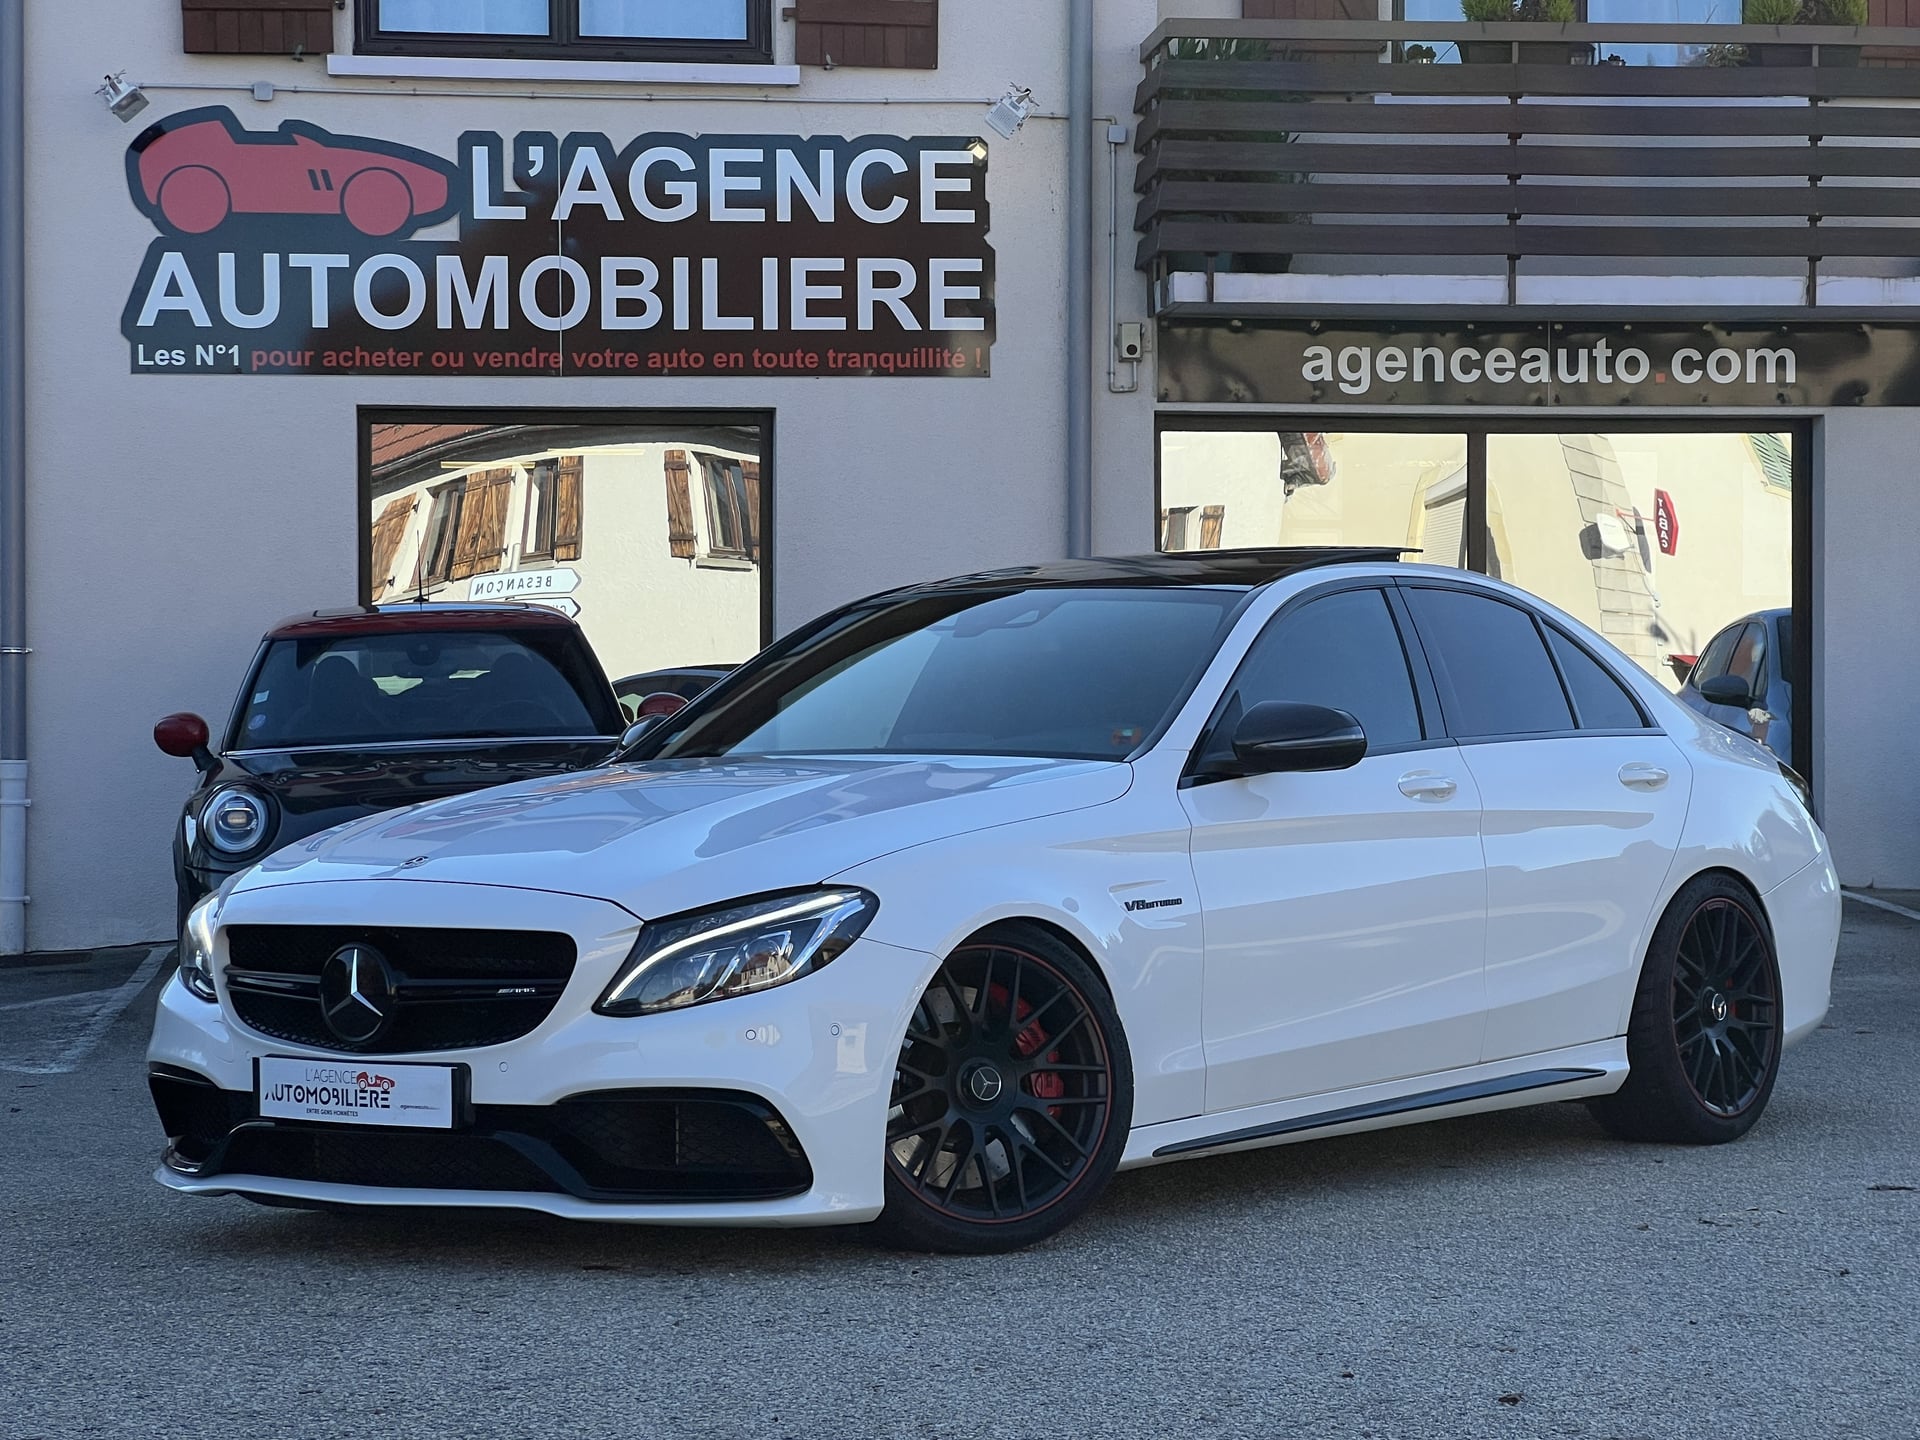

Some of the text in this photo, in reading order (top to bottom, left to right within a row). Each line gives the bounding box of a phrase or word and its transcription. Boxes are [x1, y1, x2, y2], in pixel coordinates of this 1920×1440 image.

[135, 251, 986, 332] AUTOMOBILIERE
[136, 344, 186, 367] Les
[195, 344, 242, 367] N°1
[250, 349, 315, 371] pour
[322, 346, 424, 368] acheter
[431, 350, 465, 368] ou
[472, 347, 563, 369] vendre
[571, 350, 639, 368] votre
[647, 350, 705, 369] auto
[712, 352, 745, 369] en
[751, 349, 820, 369] toute
[826, 347, 967, 372] tranquillité
[1301, 337, 1798, 395] agenceauto.com
[305, 1068, 358, 1085] L'AGENCE
